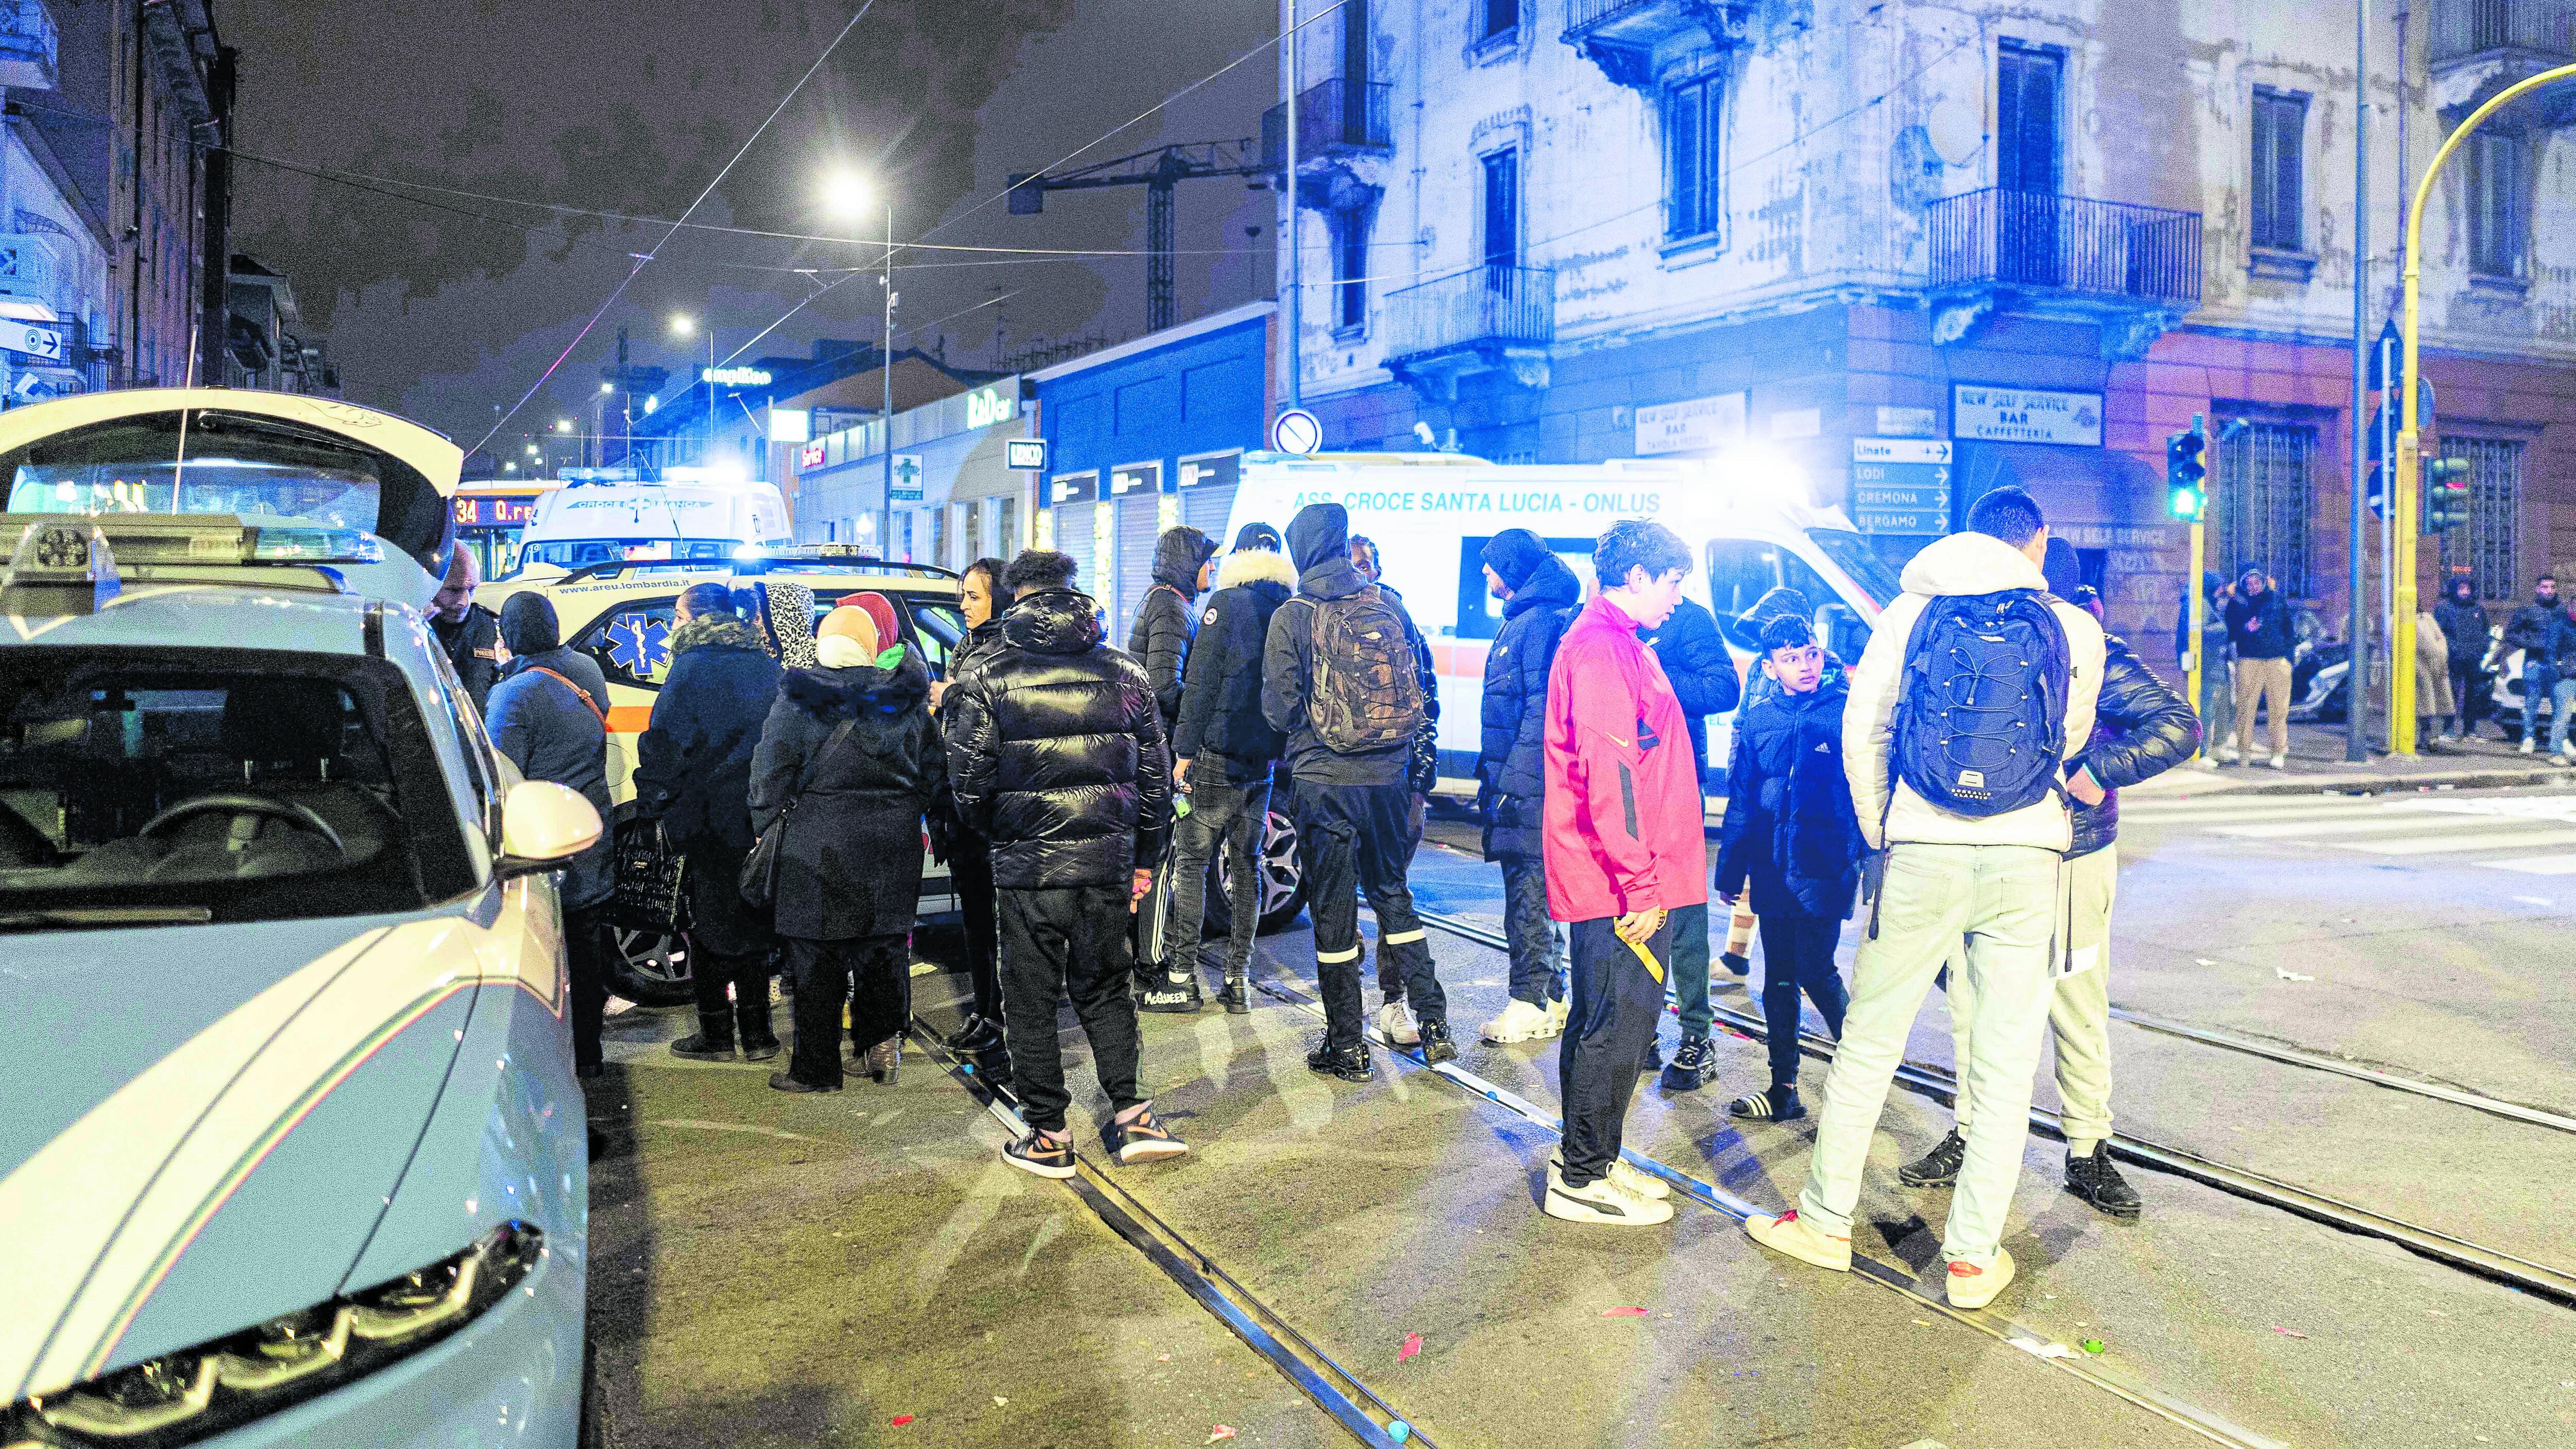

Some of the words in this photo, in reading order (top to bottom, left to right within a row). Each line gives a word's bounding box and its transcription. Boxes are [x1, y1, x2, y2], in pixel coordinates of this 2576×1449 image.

[1961, 391, 1987, 405] NEW
[2000, 411, 2028, 425] BAR
[1665, 424, 1686, 436] BAR
[1977, 425, 2053, 439] CAFFETTERIA
[1857, 445, 1891, 456] Linate
[1857, 467, 1885, 480] LODI
[1344, 493, 1415, 511] CROCE
[1421, 493, 1492, 512] SANTA
[1499, 493, 1562, 512] LUCIA
[1584, 493, 1660, 513] ONLUS
[1858, 491, 1918, 504] CREMONA
[455, 499, 477, 524] 34
[1858, 515, 1917, 528] BERGAMO
[560, 580, 690, 594] www.areu.lombardia.it
[1144, 990, 1188, 1005] McQUEEN
